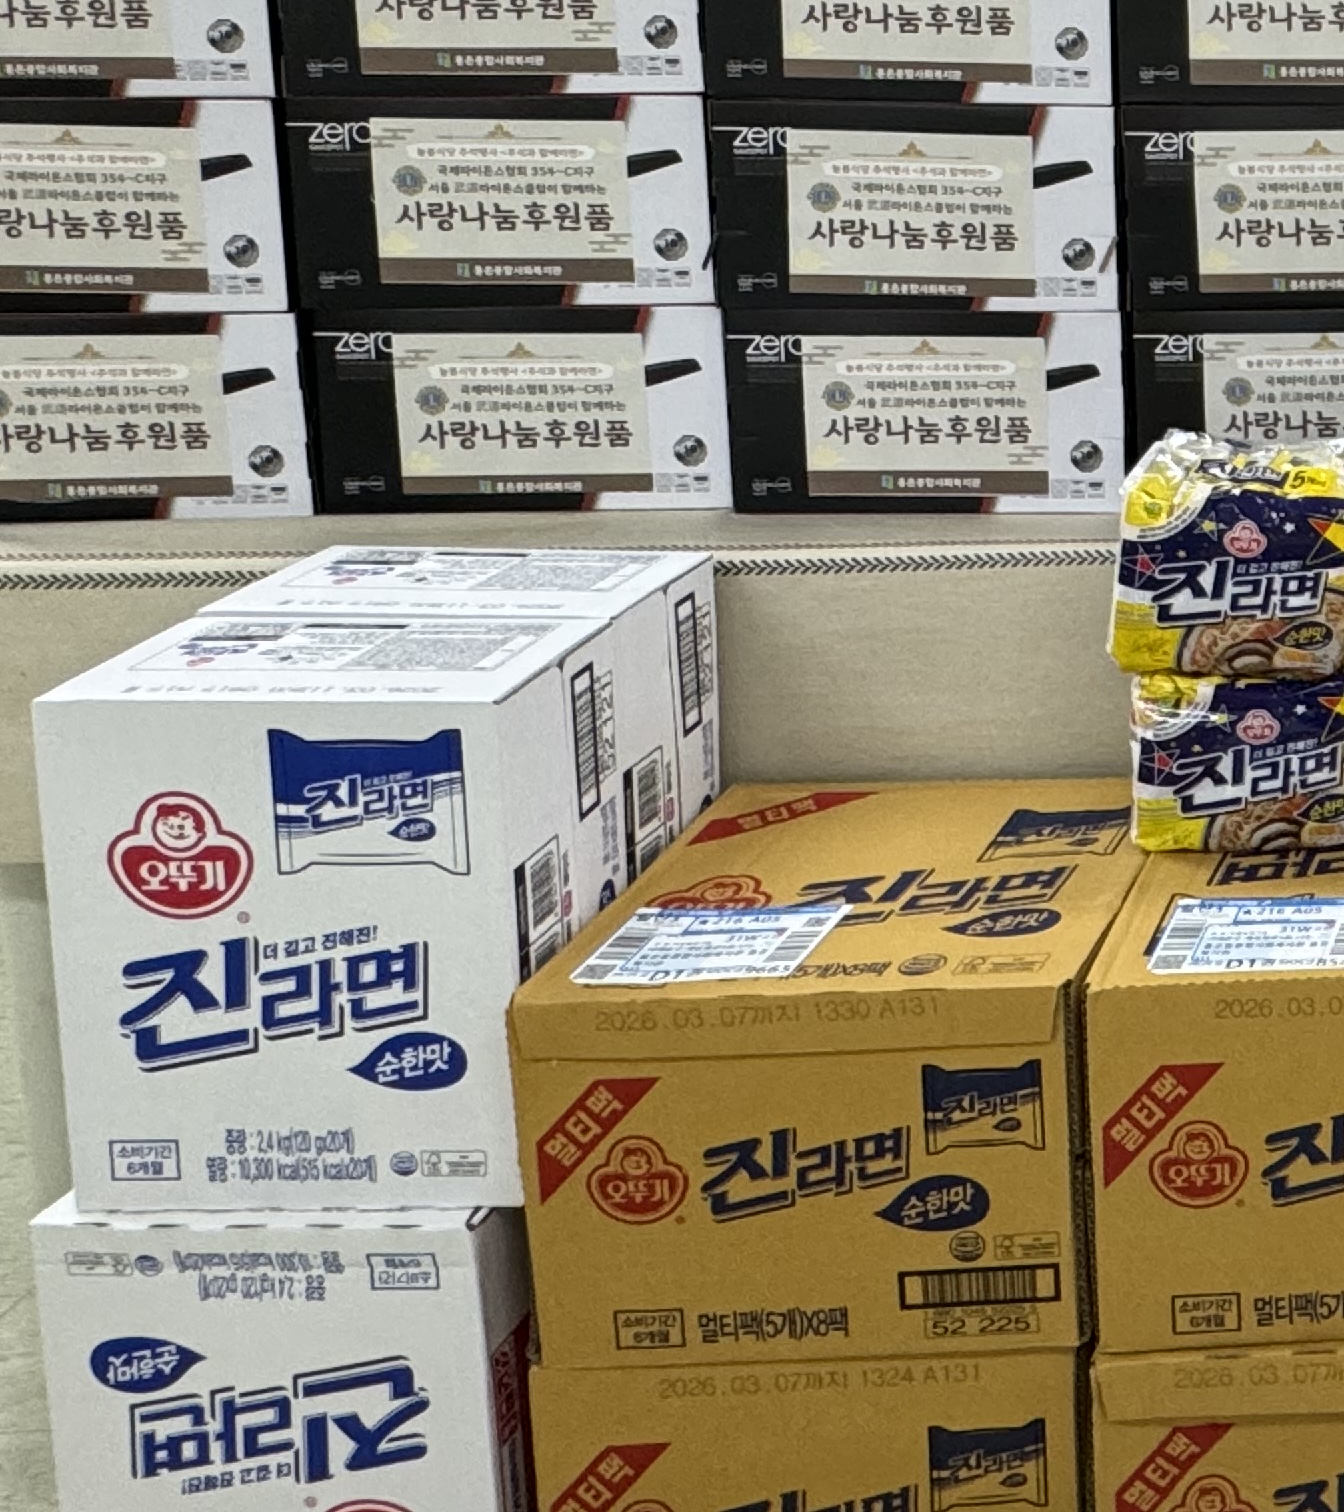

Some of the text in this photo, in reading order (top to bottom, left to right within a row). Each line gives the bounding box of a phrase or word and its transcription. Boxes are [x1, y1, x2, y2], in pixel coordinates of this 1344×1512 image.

[802, 3, 1015, 35] 사랑나눔후원품
[396, 202, 613, 233] 사랑나눔후원품
[808, 220, 1019, 251] 사랑나눔후원품
[418, 420, 633, 450] 사랑나눔후원품
[822, 415, 1032, 447] 사랑나눔후원품
[1150, 558, 1328, 628] 진라면
[1173, 737, 1344, 818] 진라면
[303, 775, 435, 832] 진라면
[140, 860, 228, 893] 오뚜기
[263, 942, 278, 961] 더
[321, 924, 379, 952] 진해진!
[119, 935, 429, 1074] 진라면
[374, 1040, 452, 1084] 순한맛
[542, 1084, 626, 1168] 멀티팩
[1110, 1070, 1190, 1153] 멀티팩
[605, 1178, 671, 1206] 오뚜기
[701, 1125, 911, 1224] 진라면
[1168, 1162, 1232, 1189] 오뚜기
[901, 1183, 977, 1224] 순한맛
[106, 1344, 181, 1386] 순한맛
[130, 1355, 431, 1484] 진라면
